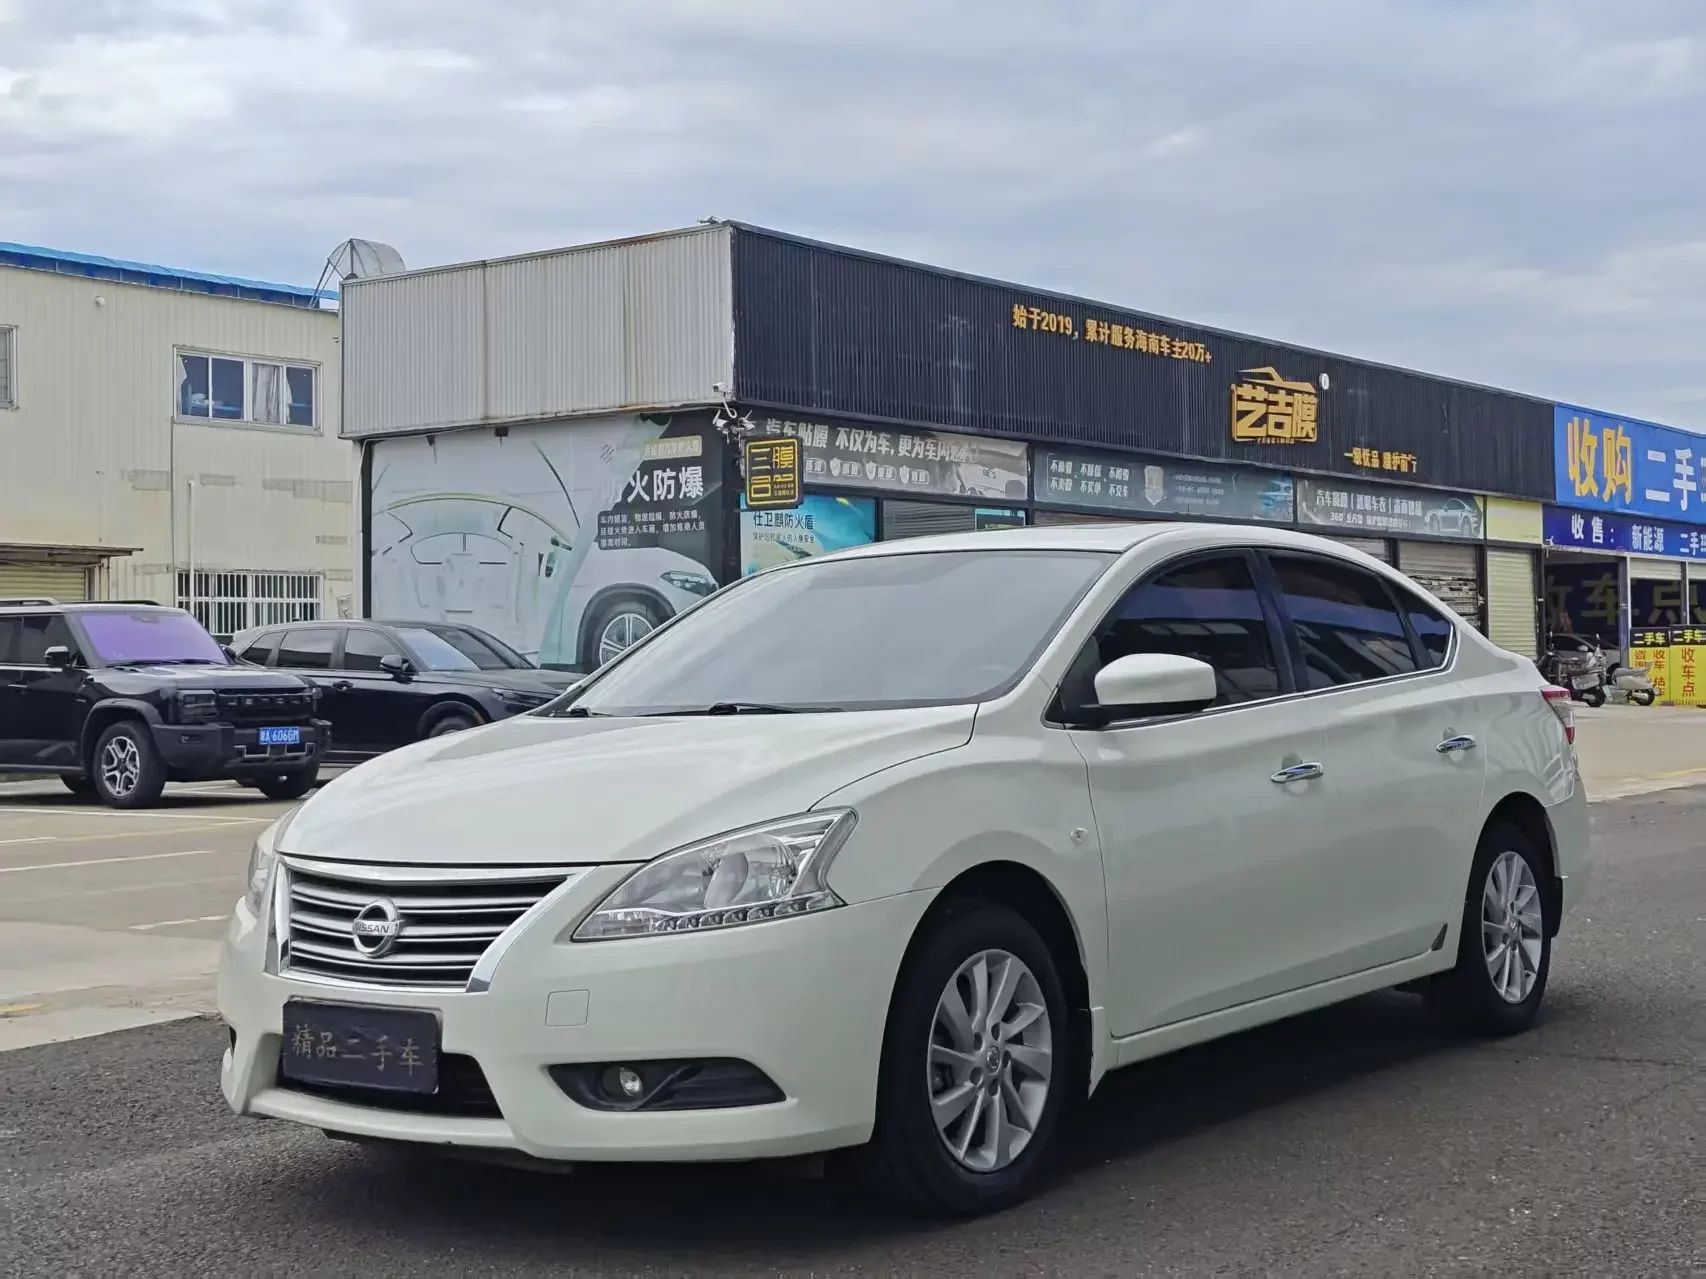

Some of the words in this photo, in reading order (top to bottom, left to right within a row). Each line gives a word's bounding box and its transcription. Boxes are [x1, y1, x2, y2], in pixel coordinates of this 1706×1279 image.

[1236, 383, 1317, 438] 艺吉膜
[1567, 416, 1632, 505] 收购
[1645, 448, 1706, 511] 二手
[1631, 524, 1664, 552] 新能源
[1679, 532, 1706, 556] 二手
[1633, 632, 1665, 645] 二手车
[1681, 647, 1695, 697] 收车点
[356, 922, 390, 934] NISSAN
[291, 1023, 423, 1077] 精品二手车
